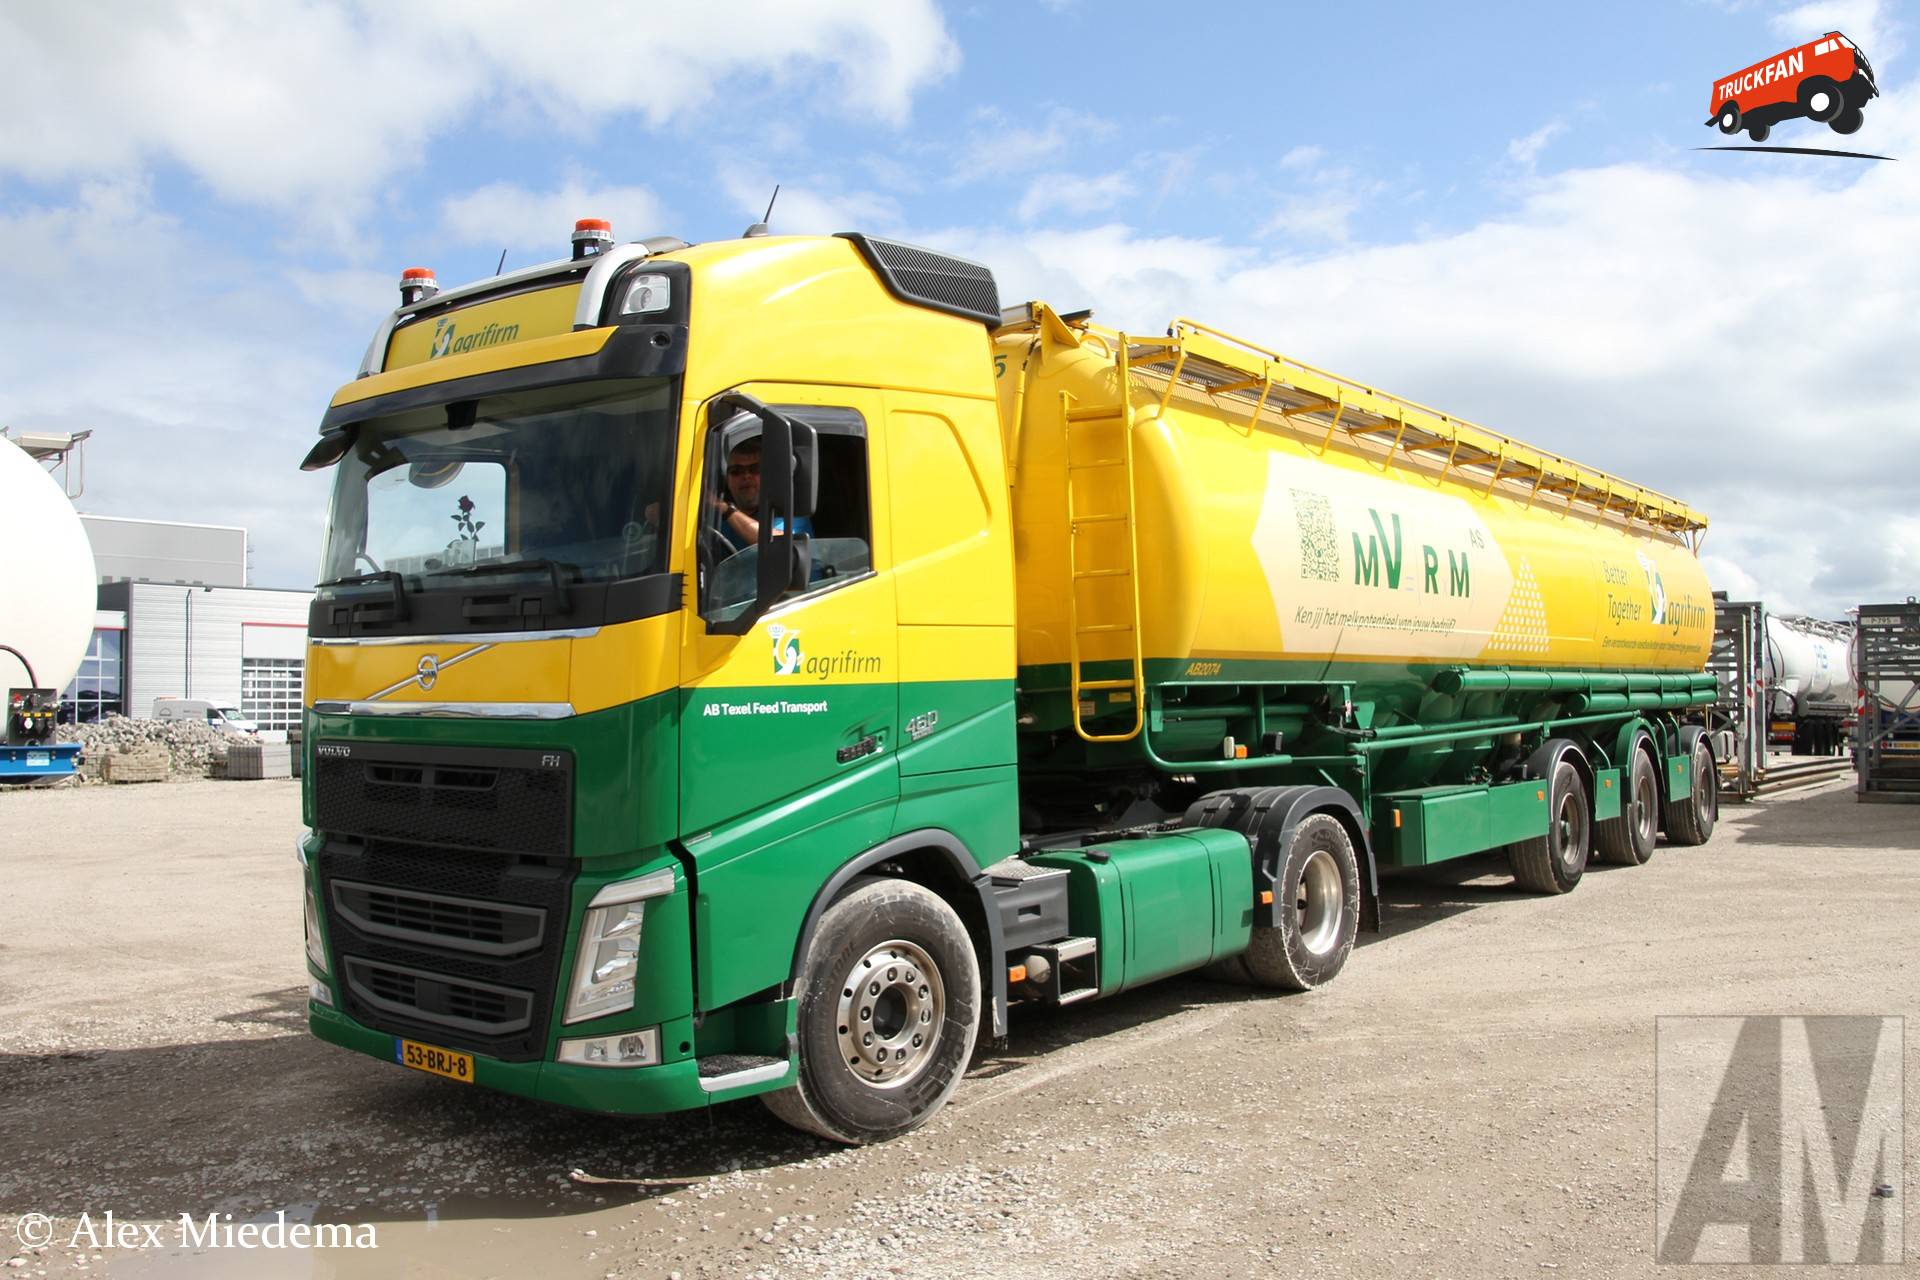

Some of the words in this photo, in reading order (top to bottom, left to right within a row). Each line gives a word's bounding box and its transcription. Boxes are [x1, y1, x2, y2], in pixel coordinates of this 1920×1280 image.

[453, 323, 519, 354] agrifirm
[1603, 561, 1629, 586] Better
[1295, 606, 1313, 624] Ken
[1311, 608, 1324, 629] jij
[1325, 608, 1338, 626] het
[1608, 594, 1642, 625] Together
[1668, 594, 1706, 636] agrifirm
[806, 650, 881, 681] agrifirm
[703, 703, 720, 716] AB
[721, 702, 752, 716] Texel
[753, 701, 779, 715] Feed
[780, 700, 828, 716] Transport
[317, 744, 351, 757] VOLVO
[541, 754, 561, 767] FH
[407, 1044, 467, 1077] 53-BRJ-8
